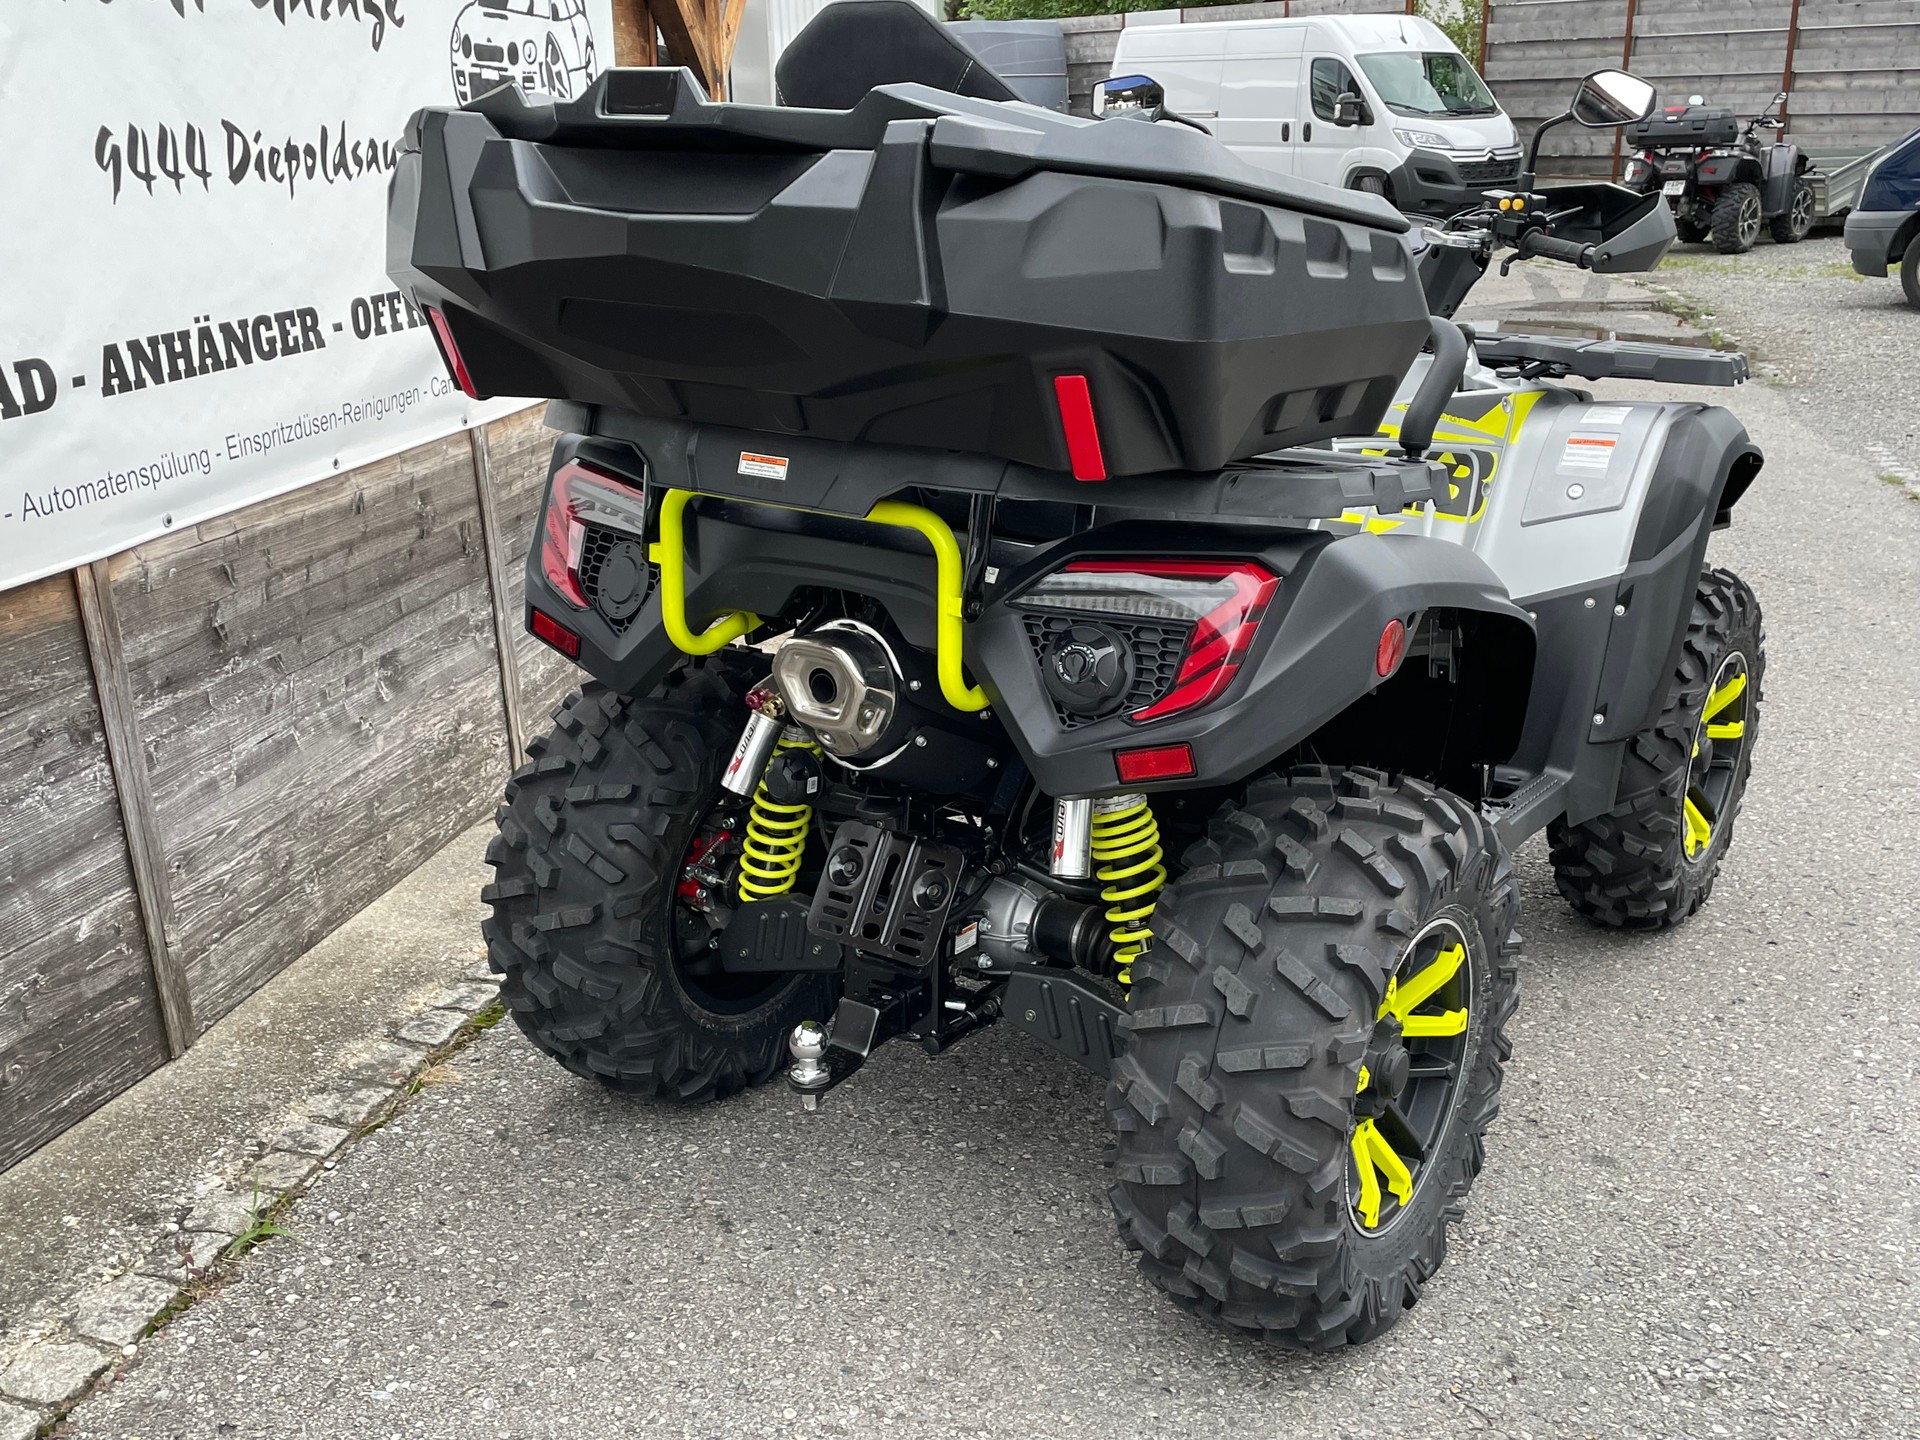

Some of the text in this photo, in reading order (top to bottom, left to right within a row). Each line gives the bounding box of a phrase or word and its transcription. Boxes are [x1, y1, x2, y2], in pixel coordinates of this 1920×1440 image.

[94, 118, 397, 205] 9444 Diepoldsau
[101, 306, 326, 397] ANHÄNGER
[22, 448, 212, 522] Automatenspülung
[225, 387, 420, 460] Einspritzdüsen-Reinigungen
